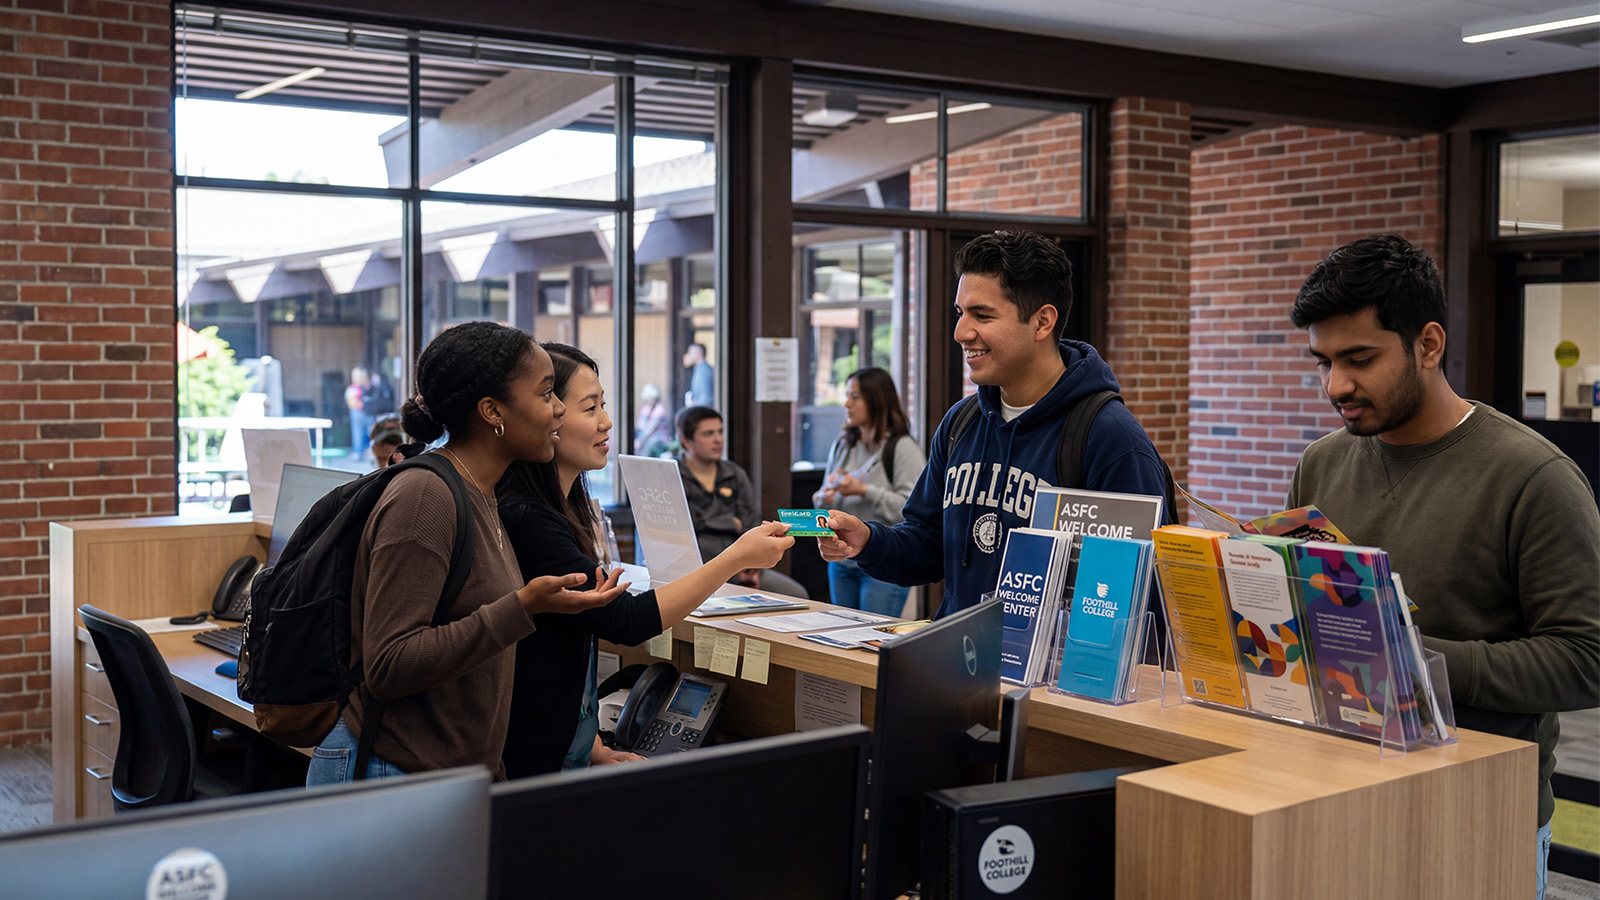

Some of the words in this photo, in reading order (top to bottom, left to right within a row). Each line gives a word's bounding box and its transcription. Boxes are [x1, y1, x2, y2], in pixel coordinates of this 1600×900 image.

[943, 462, 1051, 519] COLLEG
[1060, 502, 1099, 519] ASFC
[1059, 520, 1133, 539] WELCOME
[1001, 571, 1043, 592] ASFC
[999, 589, 1040, 605] WELCOME
[1082, 597, 1119, 611] FOOTHILL
[1002, 601, 1037, 618] ENTER
[1082, 606, 1116, 619] COLLEGE
[984, 855, 1029, 870] FOOTHILL
[986, 866, 1026, 880] COLLEGE
